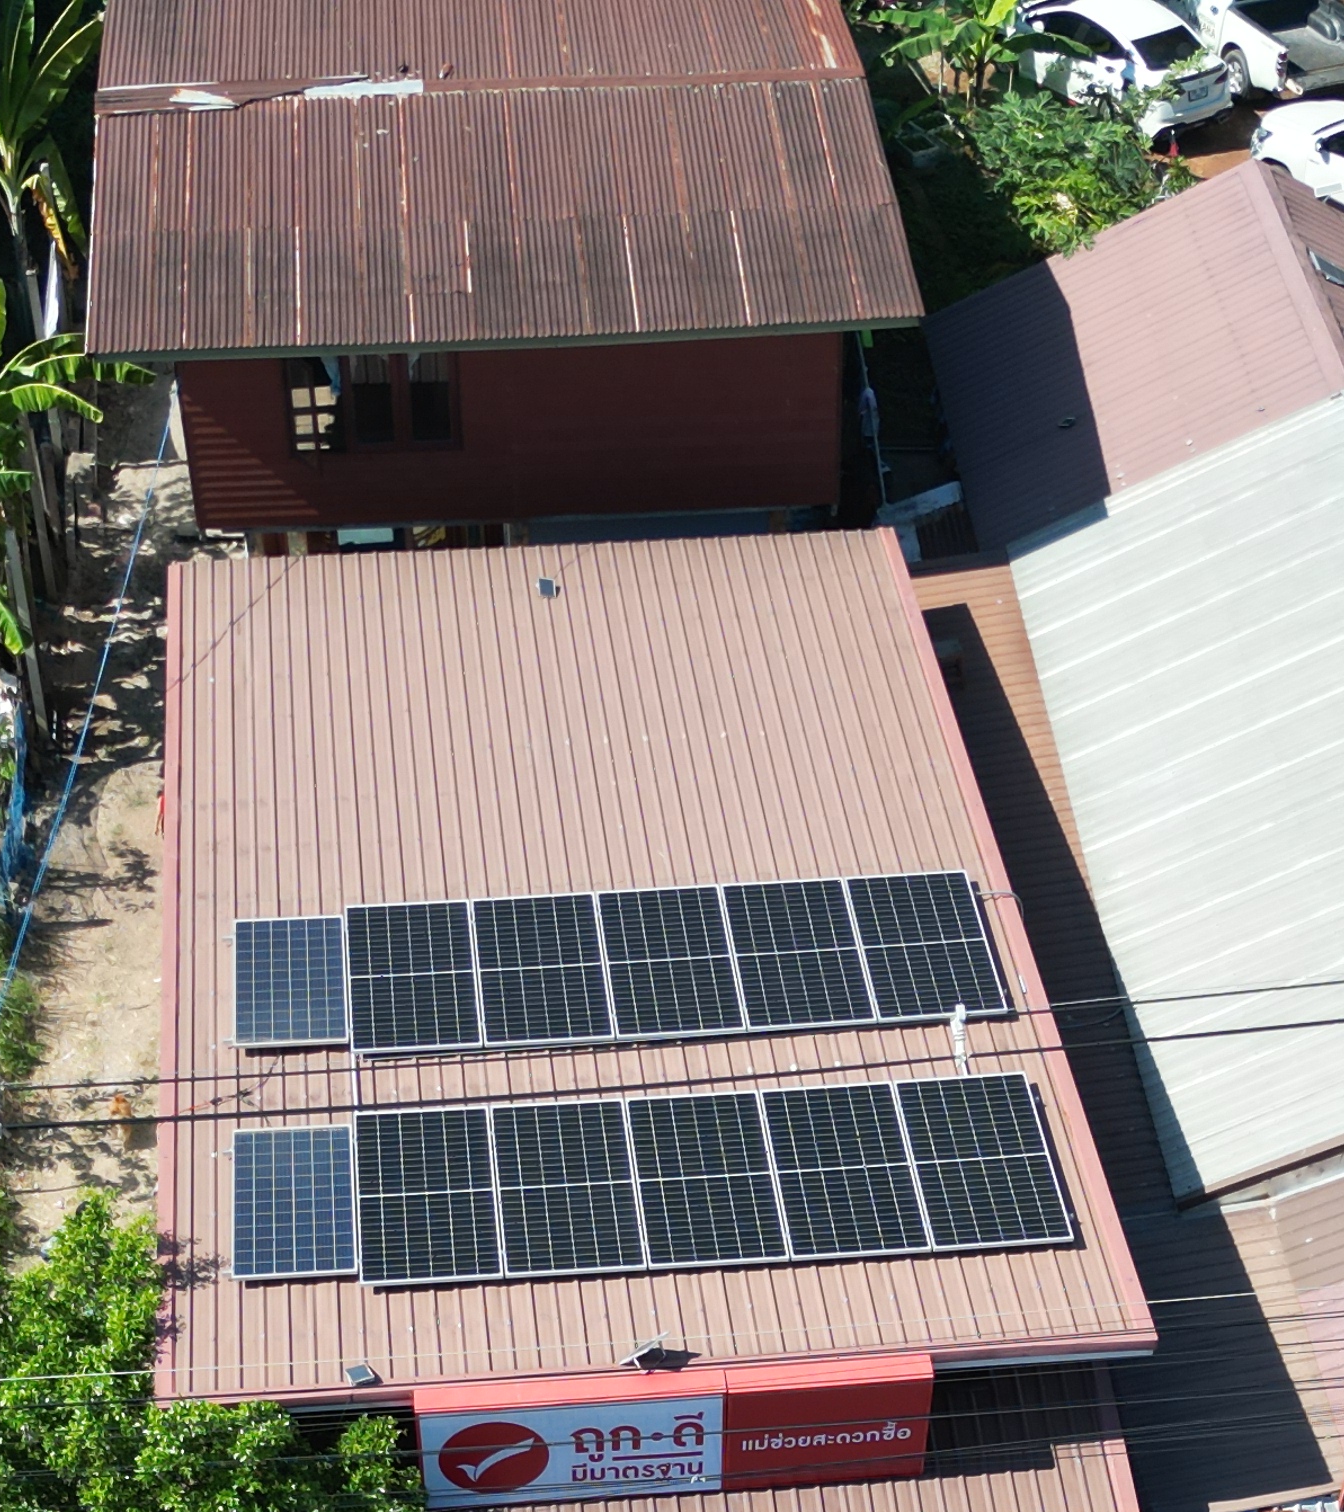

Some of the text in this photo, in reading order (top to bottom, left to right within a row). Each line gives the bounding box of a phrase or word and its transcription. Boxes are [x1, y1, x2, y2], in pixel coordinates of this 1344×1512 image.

[741, 1421, 913, 1452] แม่ช่วยสะดวกซื้อ
[570, 1459, 704, 1484] มีมาตรฐาน
